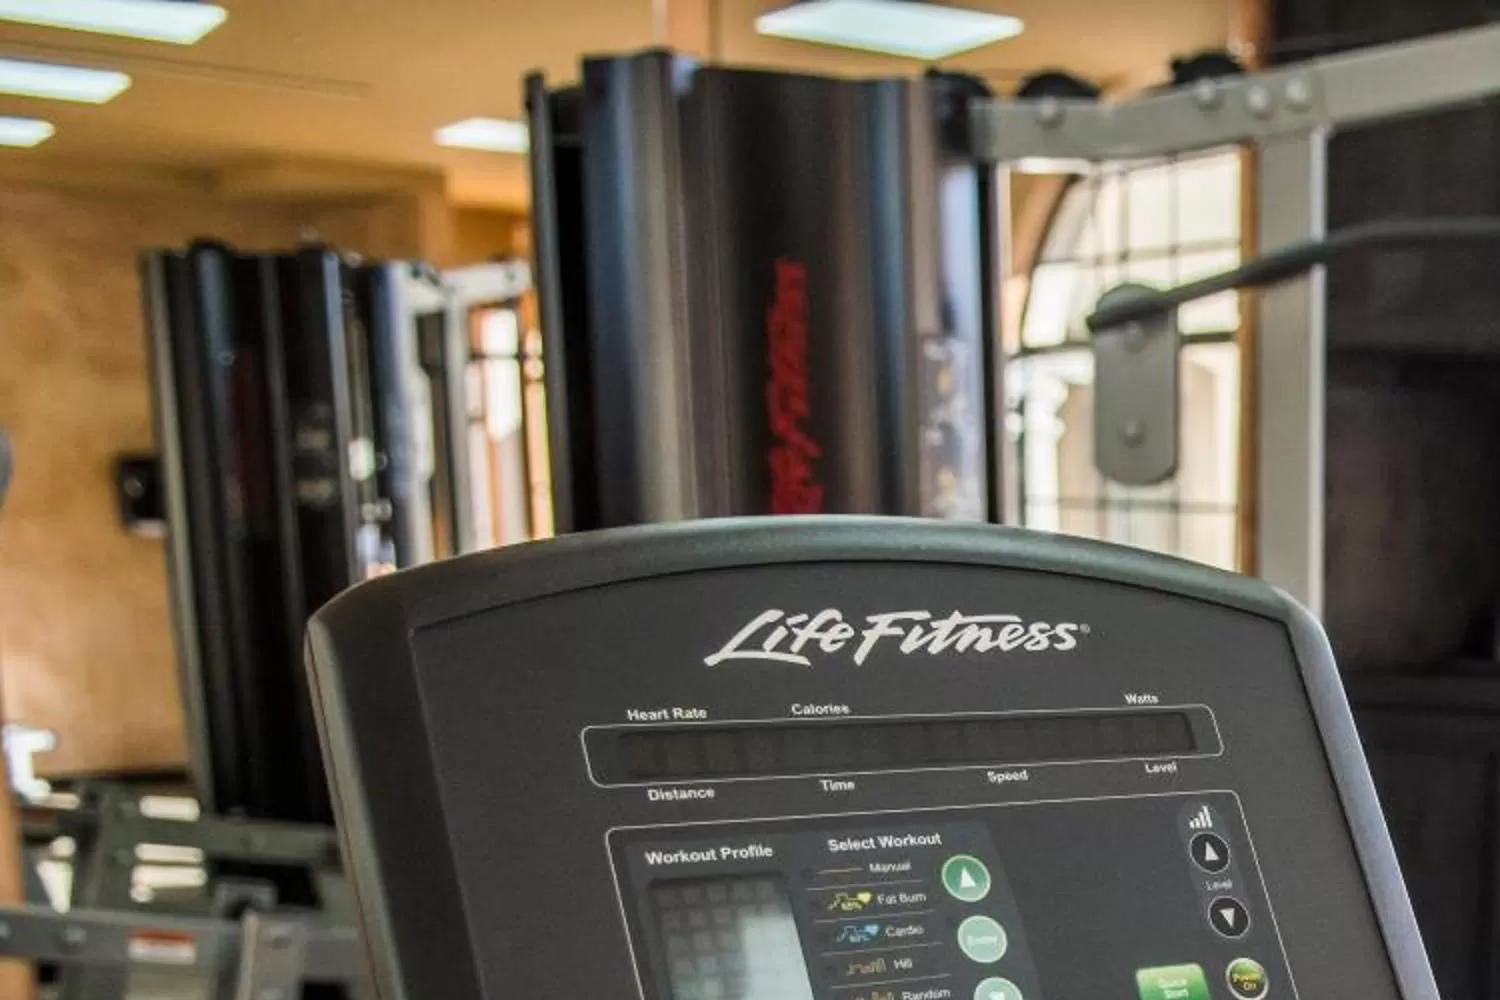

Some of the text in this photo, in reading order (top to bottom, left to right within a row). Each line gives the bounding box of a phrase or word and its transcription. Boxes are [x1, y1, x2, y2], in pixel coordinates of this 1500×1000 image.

[703, 608, 1079, 667] Life Fitness
[1124, 693, 1159, 705] Watts
[627, 706, 708, 721] Heart Rate
[791, 703, 851, 716] Calories
[1145, 761, 1178, 774] Level
[987, 770, 1029, 784] Speed
[820, 779, 855, 791] Time
[647, 788, 716, 801] Distance
[827, 831, 943, 853] Select Workout
[644, 843, 774, 866] Workout Profile
[868, 860, 912, 873] Manual
[876, 892, 897, 905] Fat
[884, 924, 926, 938] Cardio
